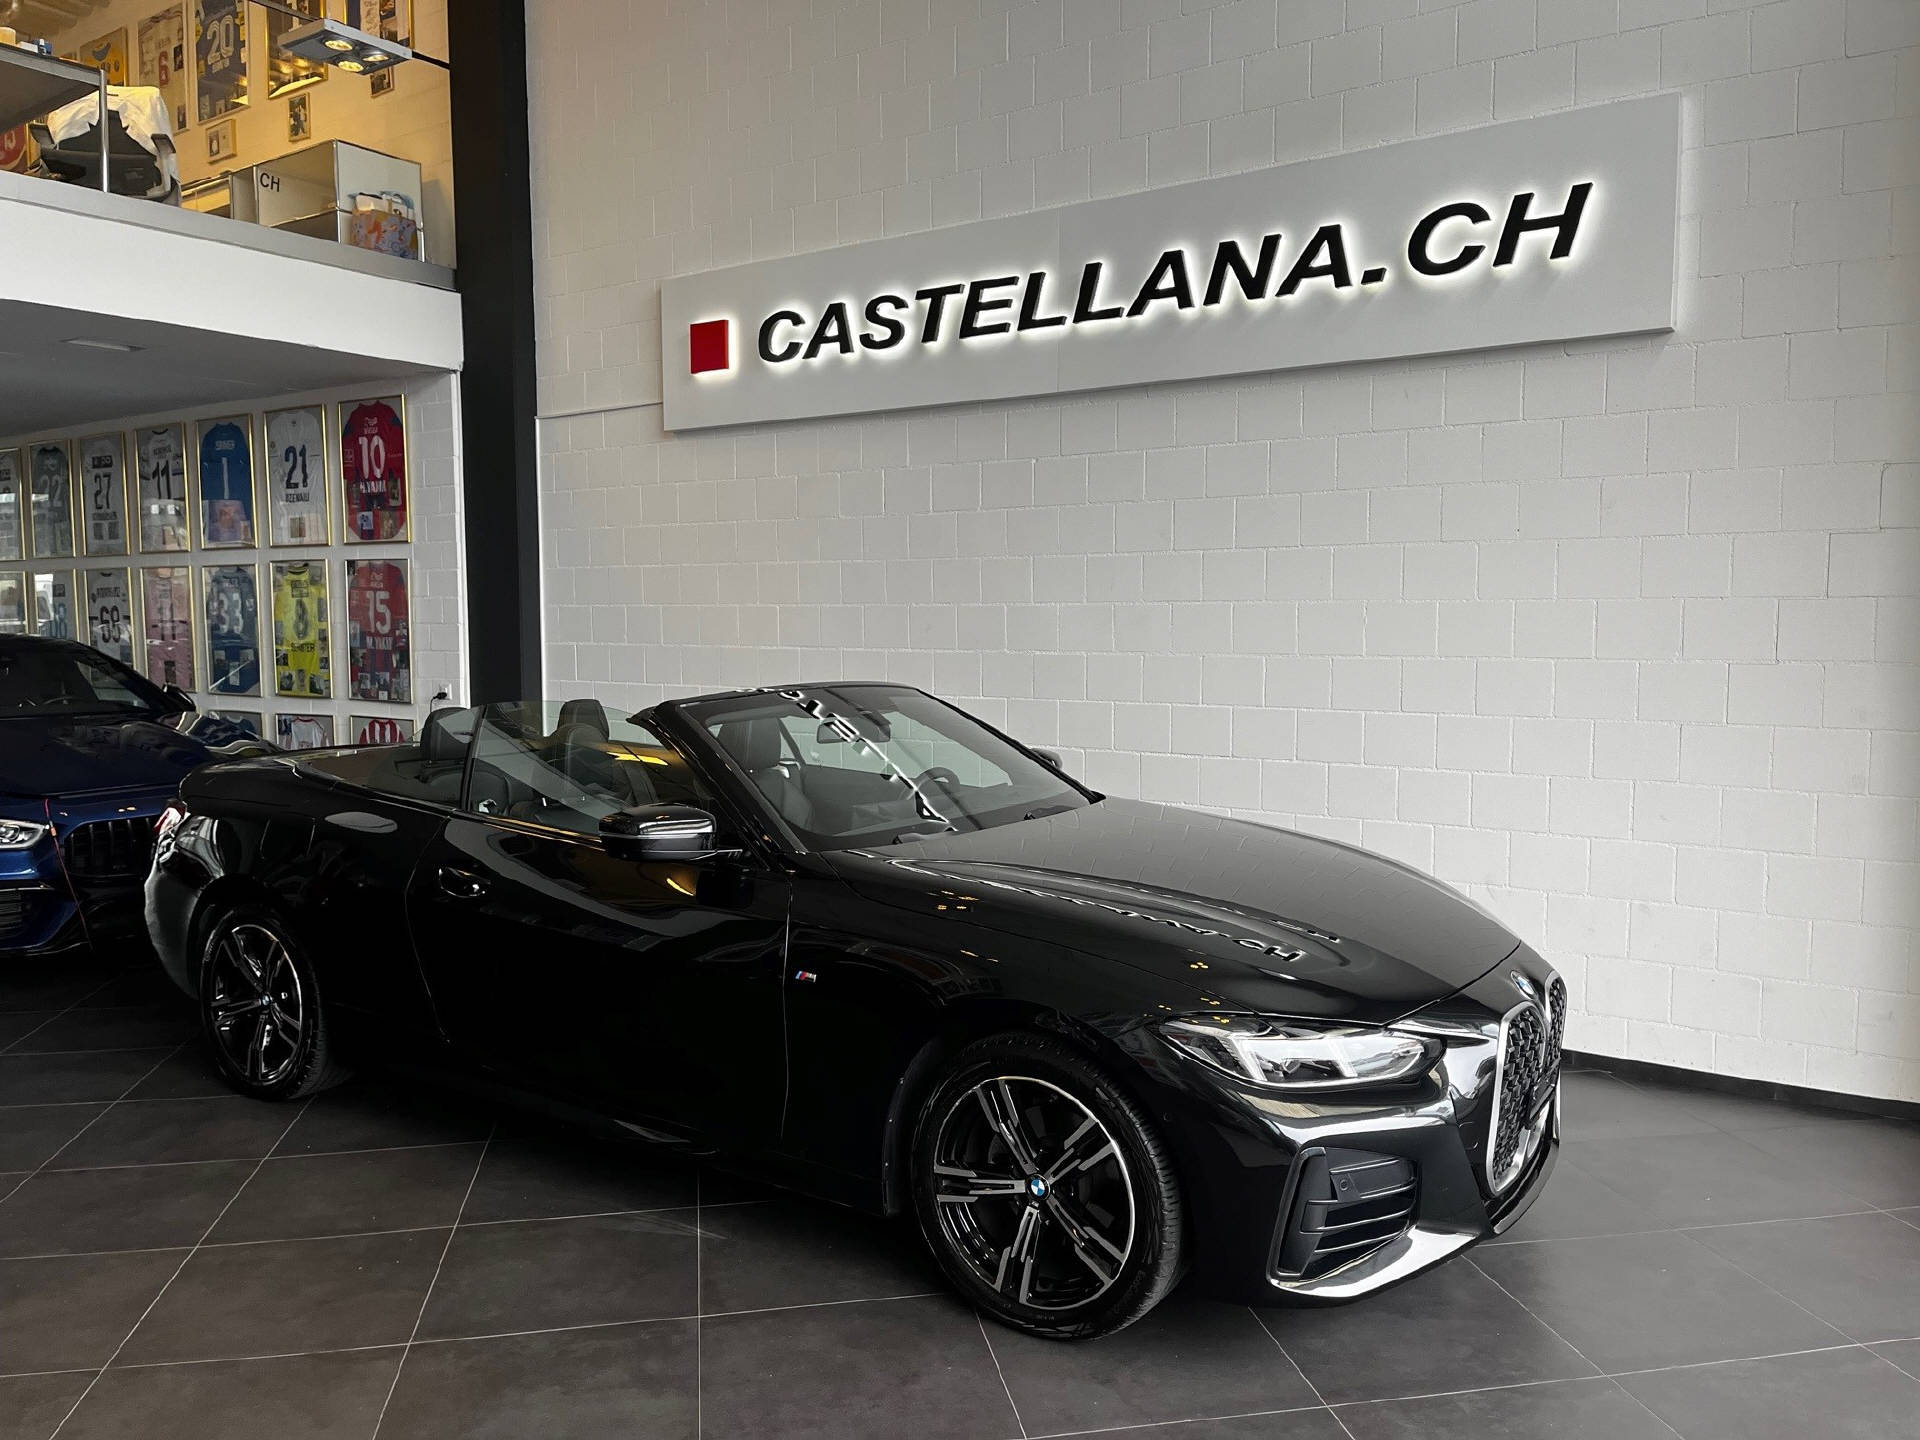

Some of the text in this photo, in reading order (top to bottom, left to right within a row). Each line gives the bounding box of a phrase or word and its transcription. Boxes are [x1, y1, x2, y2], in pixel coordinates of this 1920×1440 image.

[259, 172, 281, 193] CH
[757, 182, 1594, 364] CASTELLANA.CH
[284, 444, 308, 489] 21
[358, 434, 386, 479] 10
[94, 472, 112, 510] 27
[151, 460, 171, 500] 11
[366, 590, 391, 635] 15
